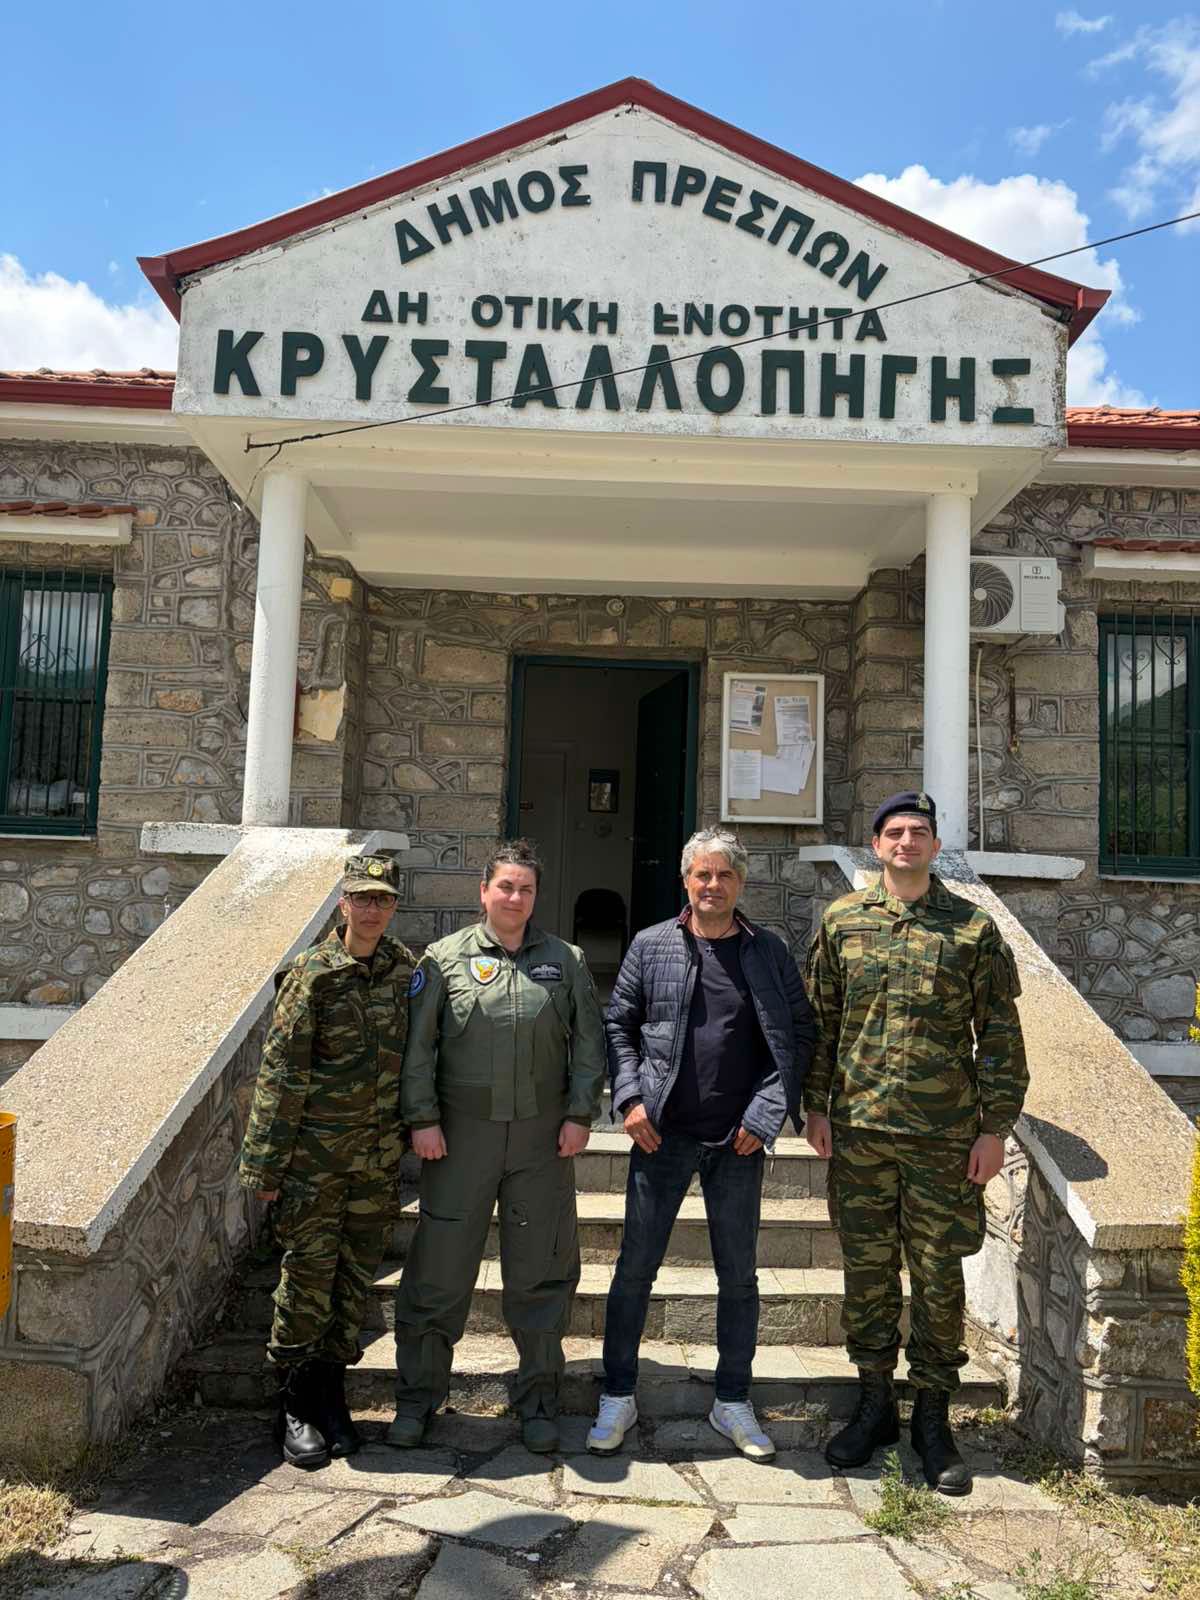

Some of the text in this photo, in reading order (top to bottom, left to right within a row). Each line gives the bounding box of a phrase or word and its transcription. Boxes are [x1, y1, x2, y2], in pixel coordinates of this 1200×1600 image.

[394, 160, 889, 302] ΔΗΜΟΣ ΠΡΕΣΠΩΝ
[360, 289, 888, 342] ΔΗΟΤΙΚΗ ΕΝΟΤΗΤΑ
